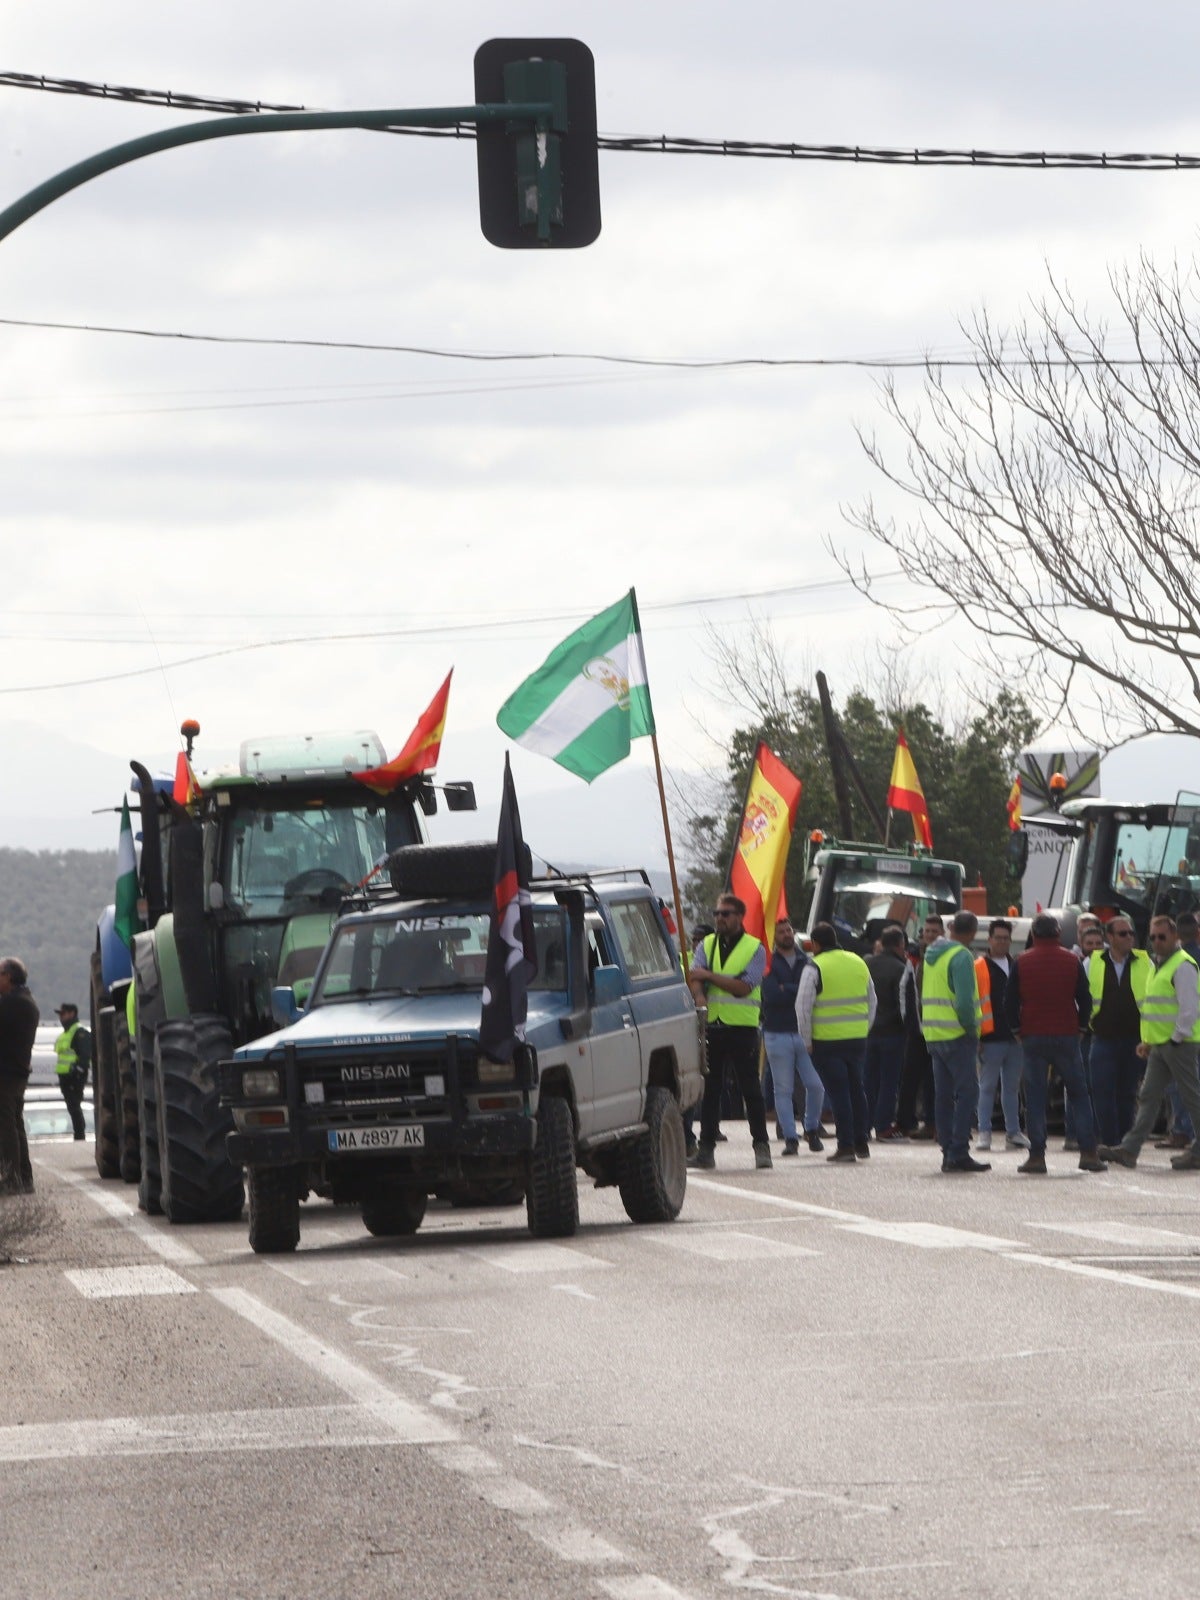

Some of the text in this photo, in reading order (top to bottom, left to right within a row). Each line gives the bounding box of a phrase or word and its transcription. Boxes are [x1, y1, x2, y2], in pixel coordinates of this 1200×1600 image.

[341, 1064, 411, 1081] NISSAN
[337, 1125, 422, 1148] MA 4897 AK
